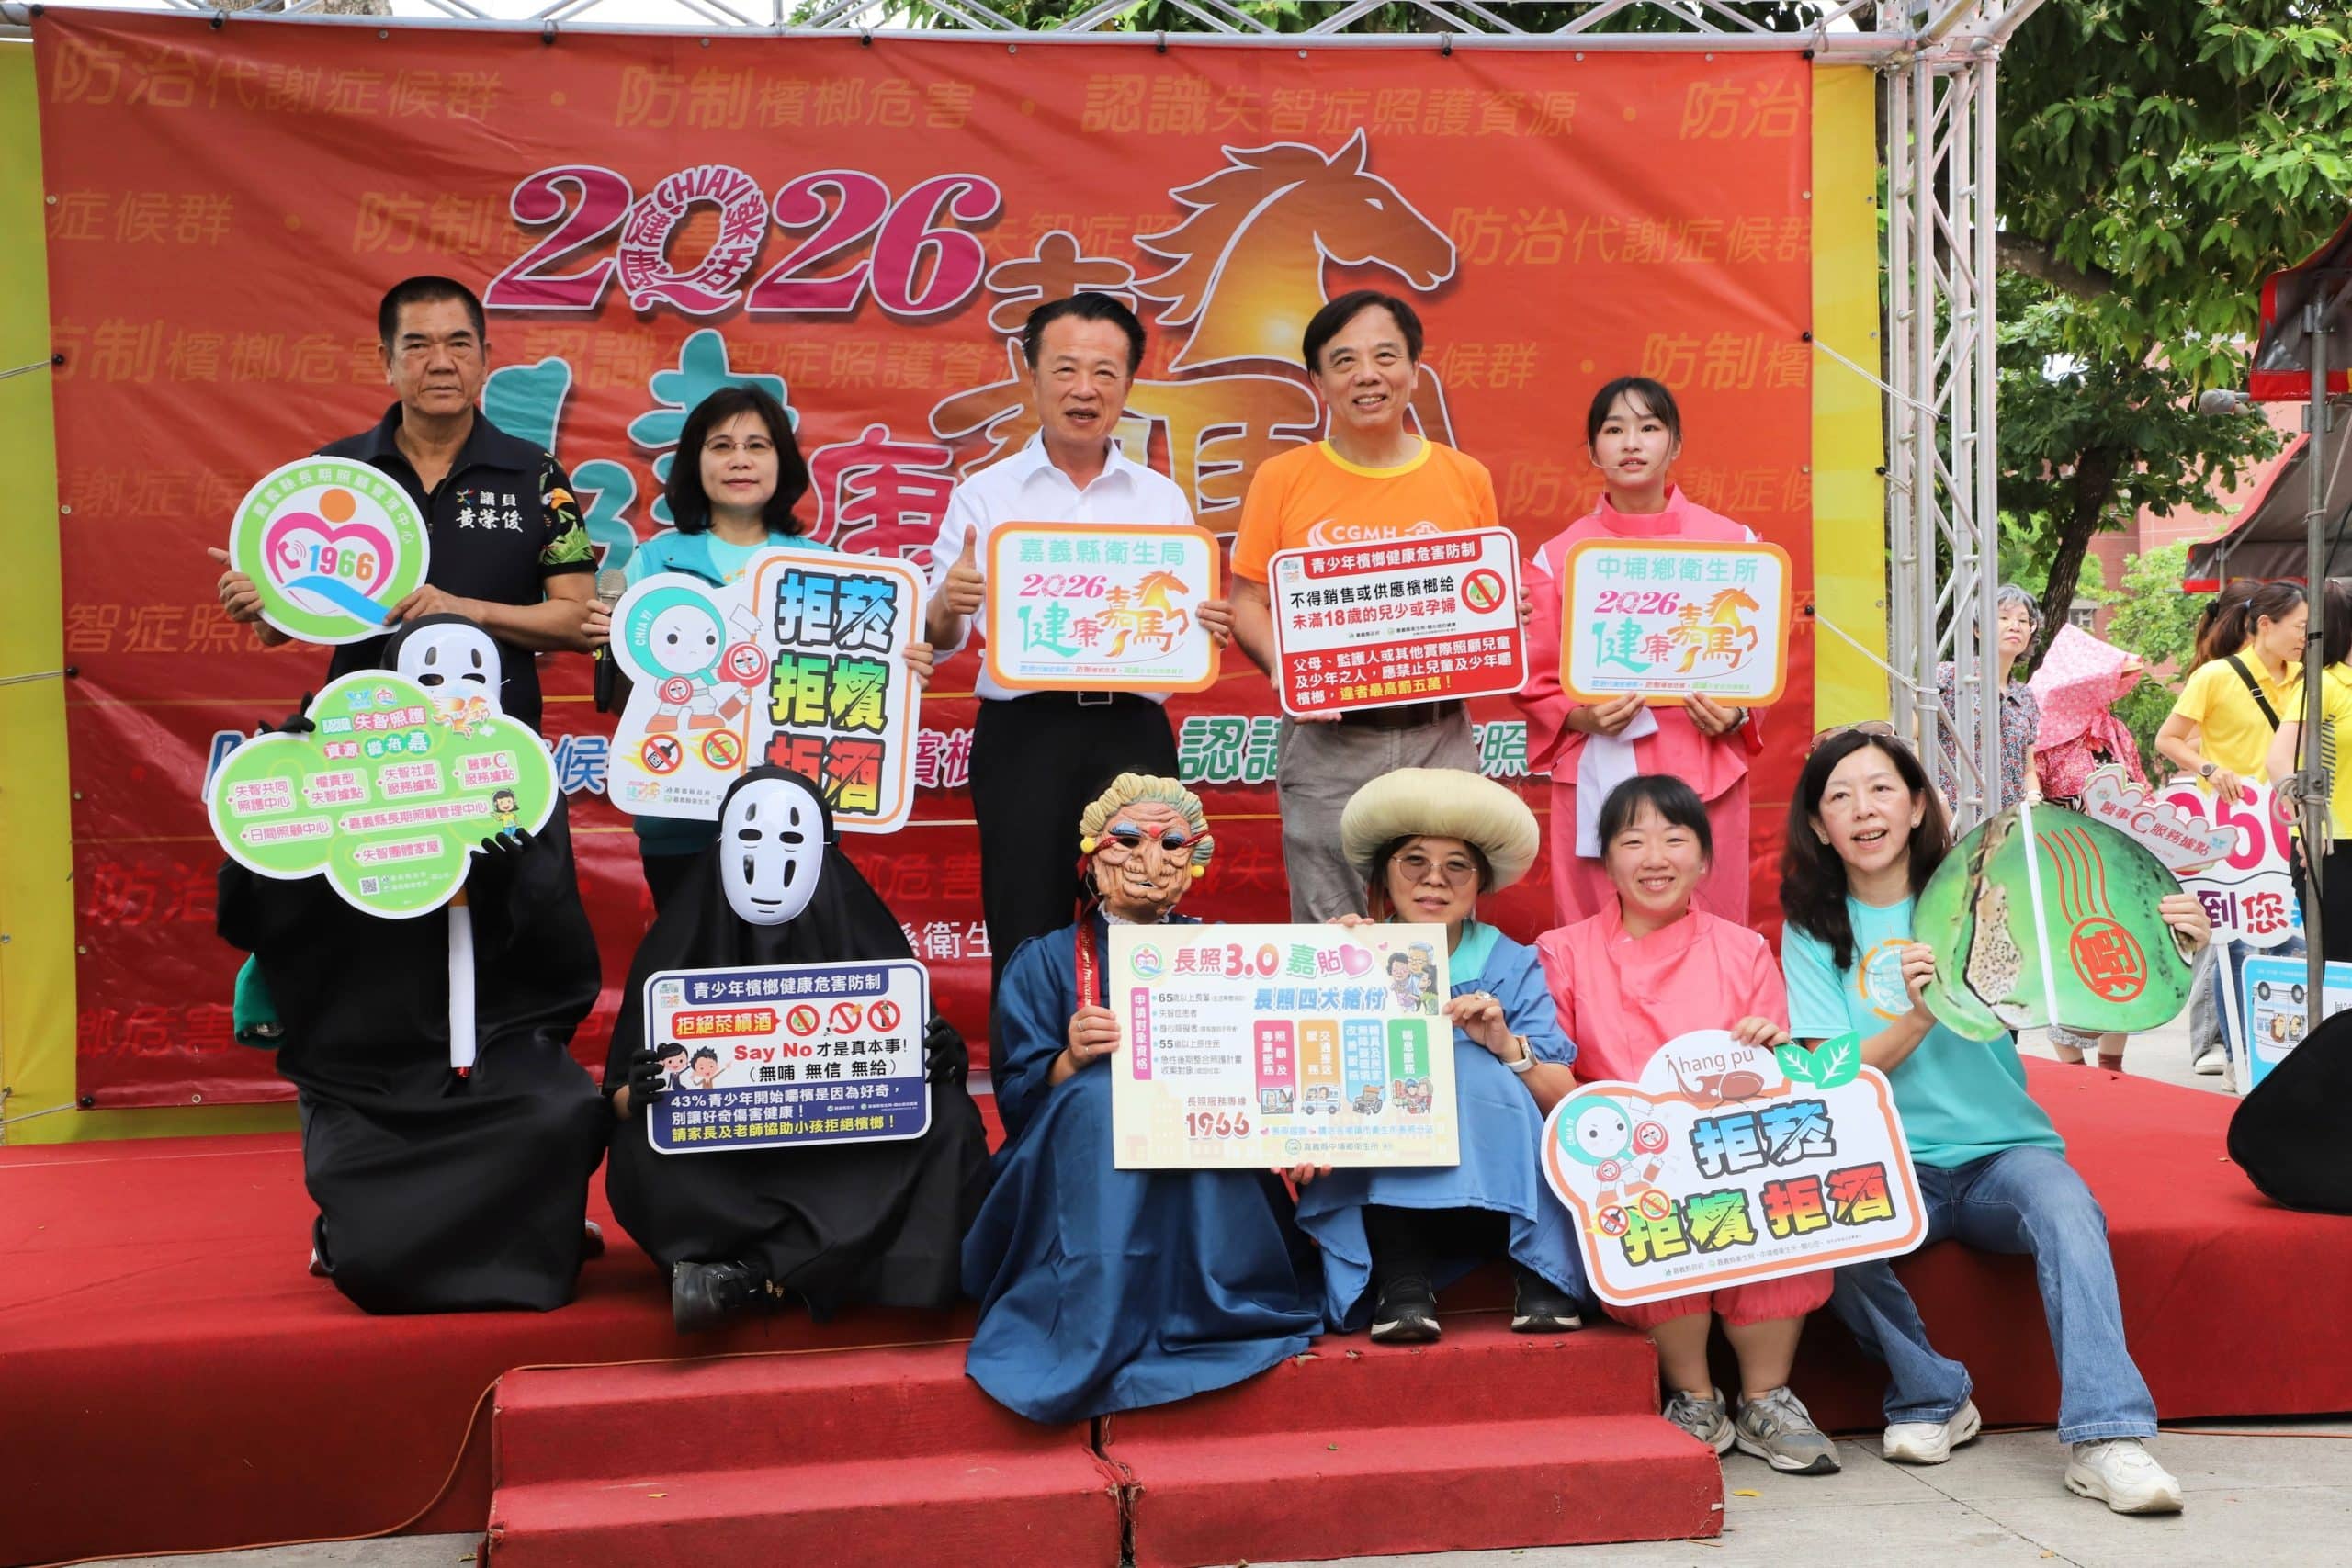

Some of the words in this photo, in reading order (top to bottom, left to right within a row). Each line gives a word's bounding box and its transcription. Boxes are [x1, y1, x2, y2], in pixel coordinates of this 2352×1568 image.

[51, 40, 503, 121] 防治代謝症候群
[615, 66, 976, 130] 防制檳榔危害
[1080, 73, 1579, 138] 認識失智症照護資源
[1679, 79, 1803, 141] 防治
[1331, 525, 1397, 542] CGMH
[310, 545, 375, 581] 1966
[1018, 538, 1185, 566] 嘉義縣衛生局
[1310, 541, 1476, 574] 青少年檳榔健康危害防制
[1596, 555, 1759, 583] 中埔鄉衛生所
[1290, 575, 1455, 609] 不得銷售或供應檳榔給
[775, 567, 898, 655] 拒菸
[1292, 598, 1457, 630] 未滿18歲的兒少或孕婦
[1293, 636, 1510, 673] 父母、監護人或其他實際照顧兒童
[768, 649, 891, 735] 拒檳
[693, 973, 881, 999] 青少年檳榔健康危害防制
[734, 1043, 775, 1063] Say
[782, 1043, 813, 1058] No
[1731, 1049, 1755, 1069] pu
[1186, 1112, 1250, 1137] 1966
[1689, 1099, 1836, 1179] 拒菸
[1621, 1188, 1758, 1267] 拒檳
[1759, 1161, 1896, 1240] 拒酒
